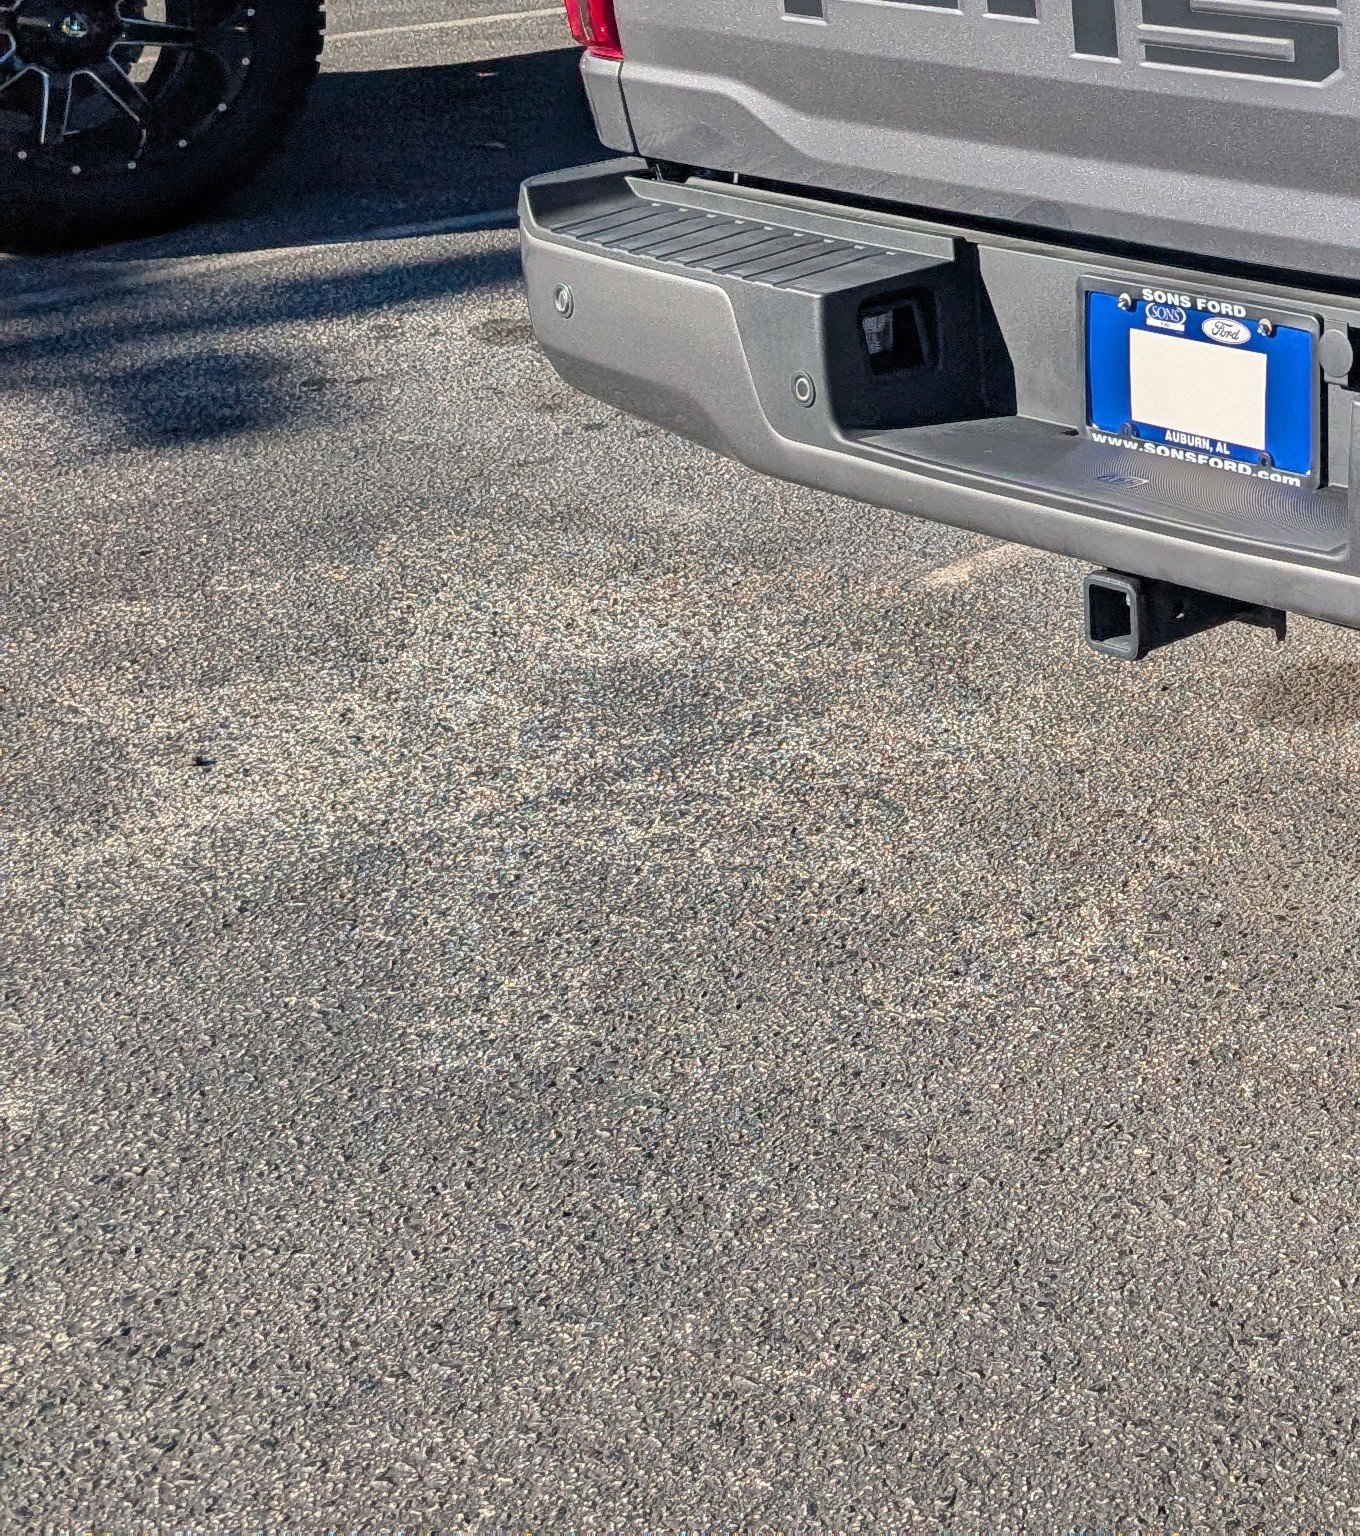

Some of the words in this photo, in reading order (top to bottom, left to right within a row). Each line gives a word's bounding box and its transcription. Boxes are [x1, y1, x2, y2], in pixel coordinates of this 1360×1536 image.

[1142, 288, 1191, 308] SONS
[1196, 297, 1246, 317] FORD
[1151, 305, 1181, 322] SONS
[1211, 320, 1241, 340] Ford
[1164, 429, 1213, 454] AUBURN,
[1216, 442, 1230, 455] AL
[1091, 432, 1301, 487] www.SONSFORD.com
